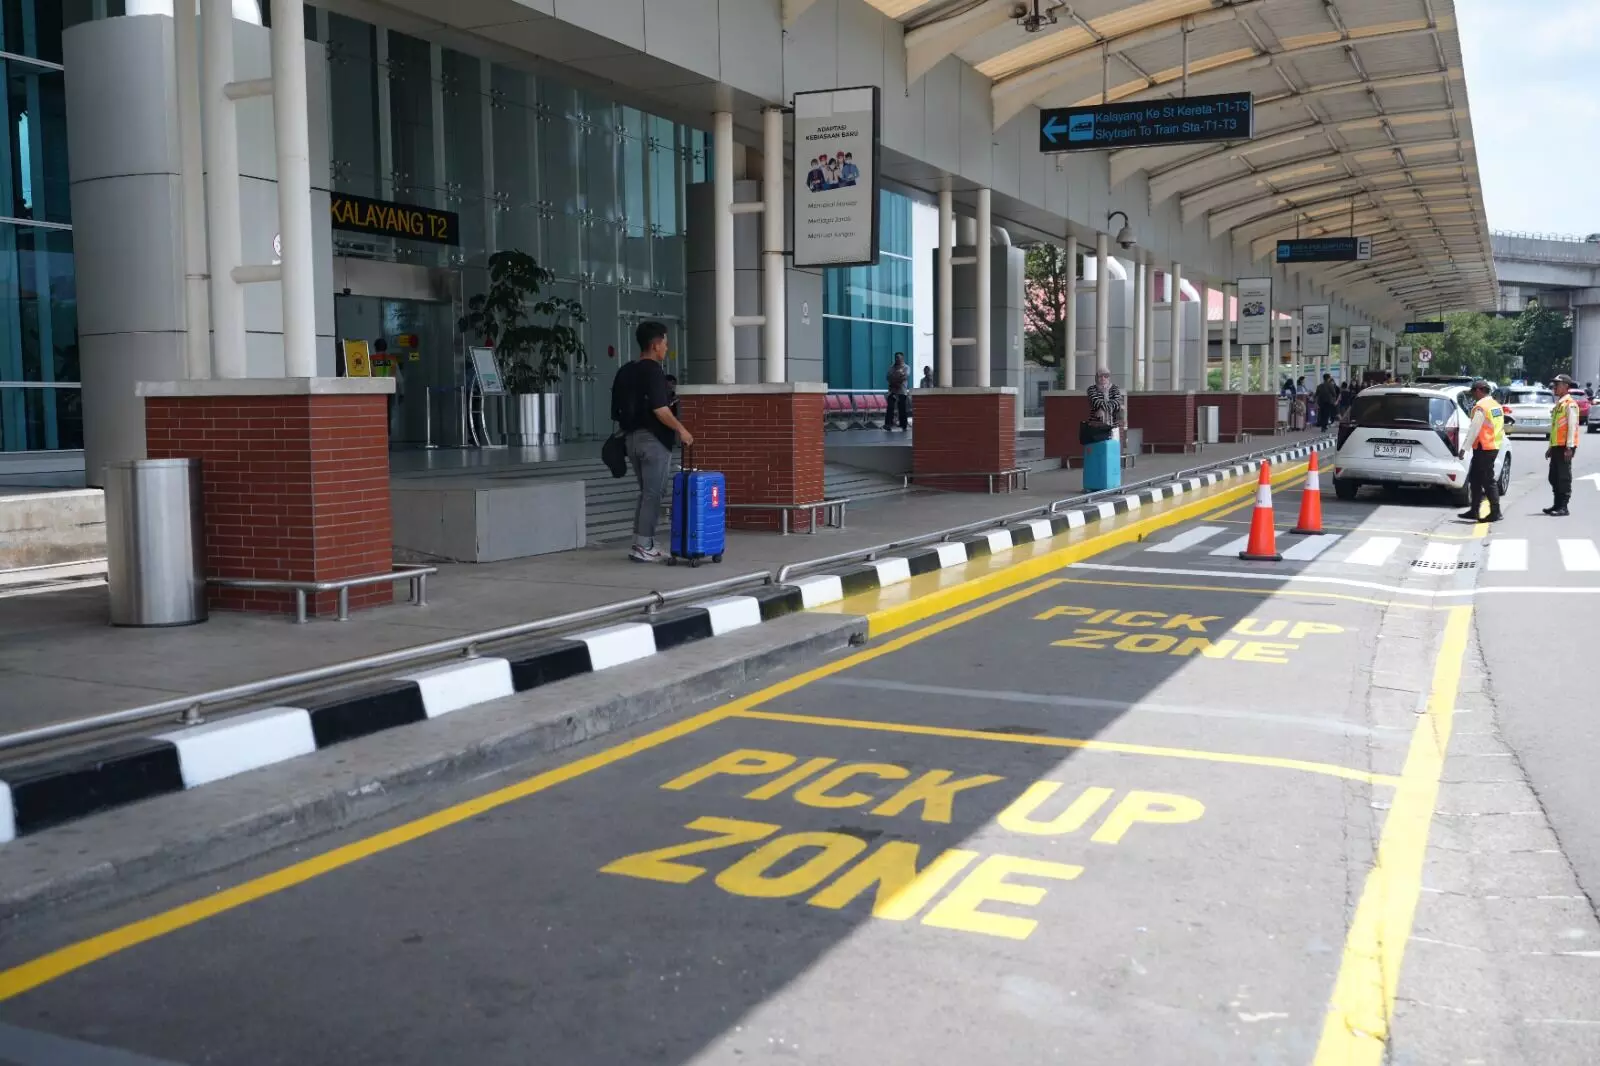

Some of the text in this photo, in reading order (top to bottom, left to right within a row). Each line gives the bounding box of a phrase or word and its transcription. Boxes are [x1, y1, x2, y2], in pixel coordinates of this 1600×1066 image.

[1095, 118, 1237, 142] Skytrain To Train Sta-T1-T3
[1146, 108, 1161, 119] Ke
[1162, 106, 1175, 118] St
[331, 199, 448, 239] KALAYANG T2
[1359, 241, 1369, 254] E
[1031, 605, 1347, 639] PICK UP
[1050, 628, 1300, 664] ZONE
[660, 748, 1206, 845] PICK UP
[598, 815, 1084, 941] ZONE
